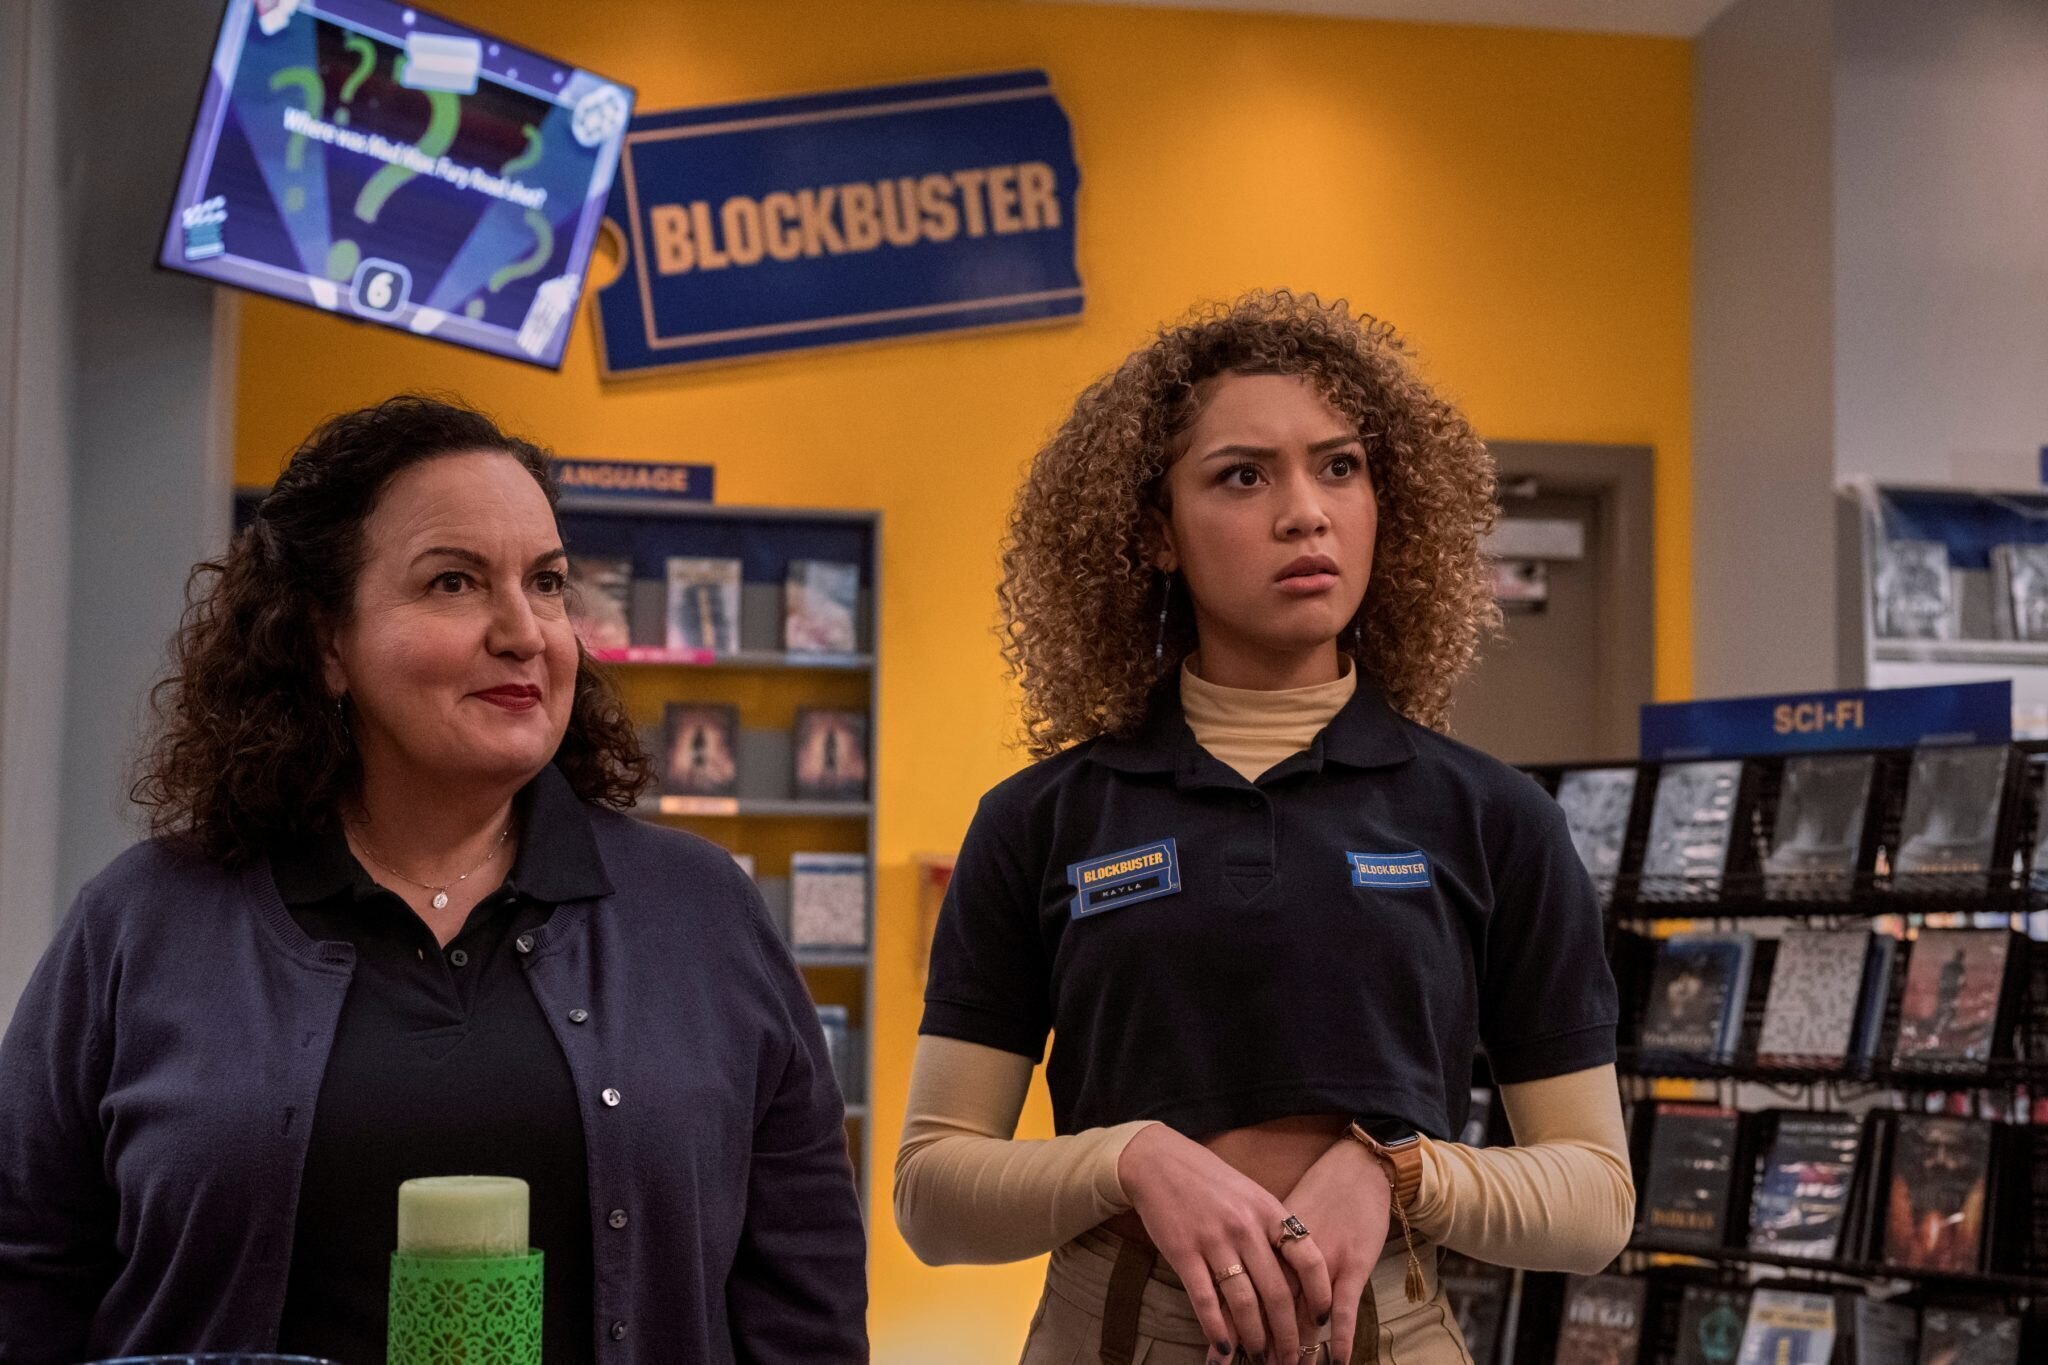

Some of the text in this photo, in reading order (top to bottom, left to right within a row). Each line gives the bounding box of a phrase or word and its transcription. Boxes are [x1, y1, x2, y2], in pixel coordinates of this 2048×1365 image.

[650, 161, 1061, 276] BLOCKBUSTER
[367, 272, 393, 309] 6
[559, 465, 688, 492] ANGUAGE
[1773, 700, 1864, 734] SCI-FI
[1083, 852, 1164, 883] BLOCKBUSTER
[1360, 863, 1426, 875] BLOCKBUSTER
[1102, 882, 1142, 897] KAYLA
